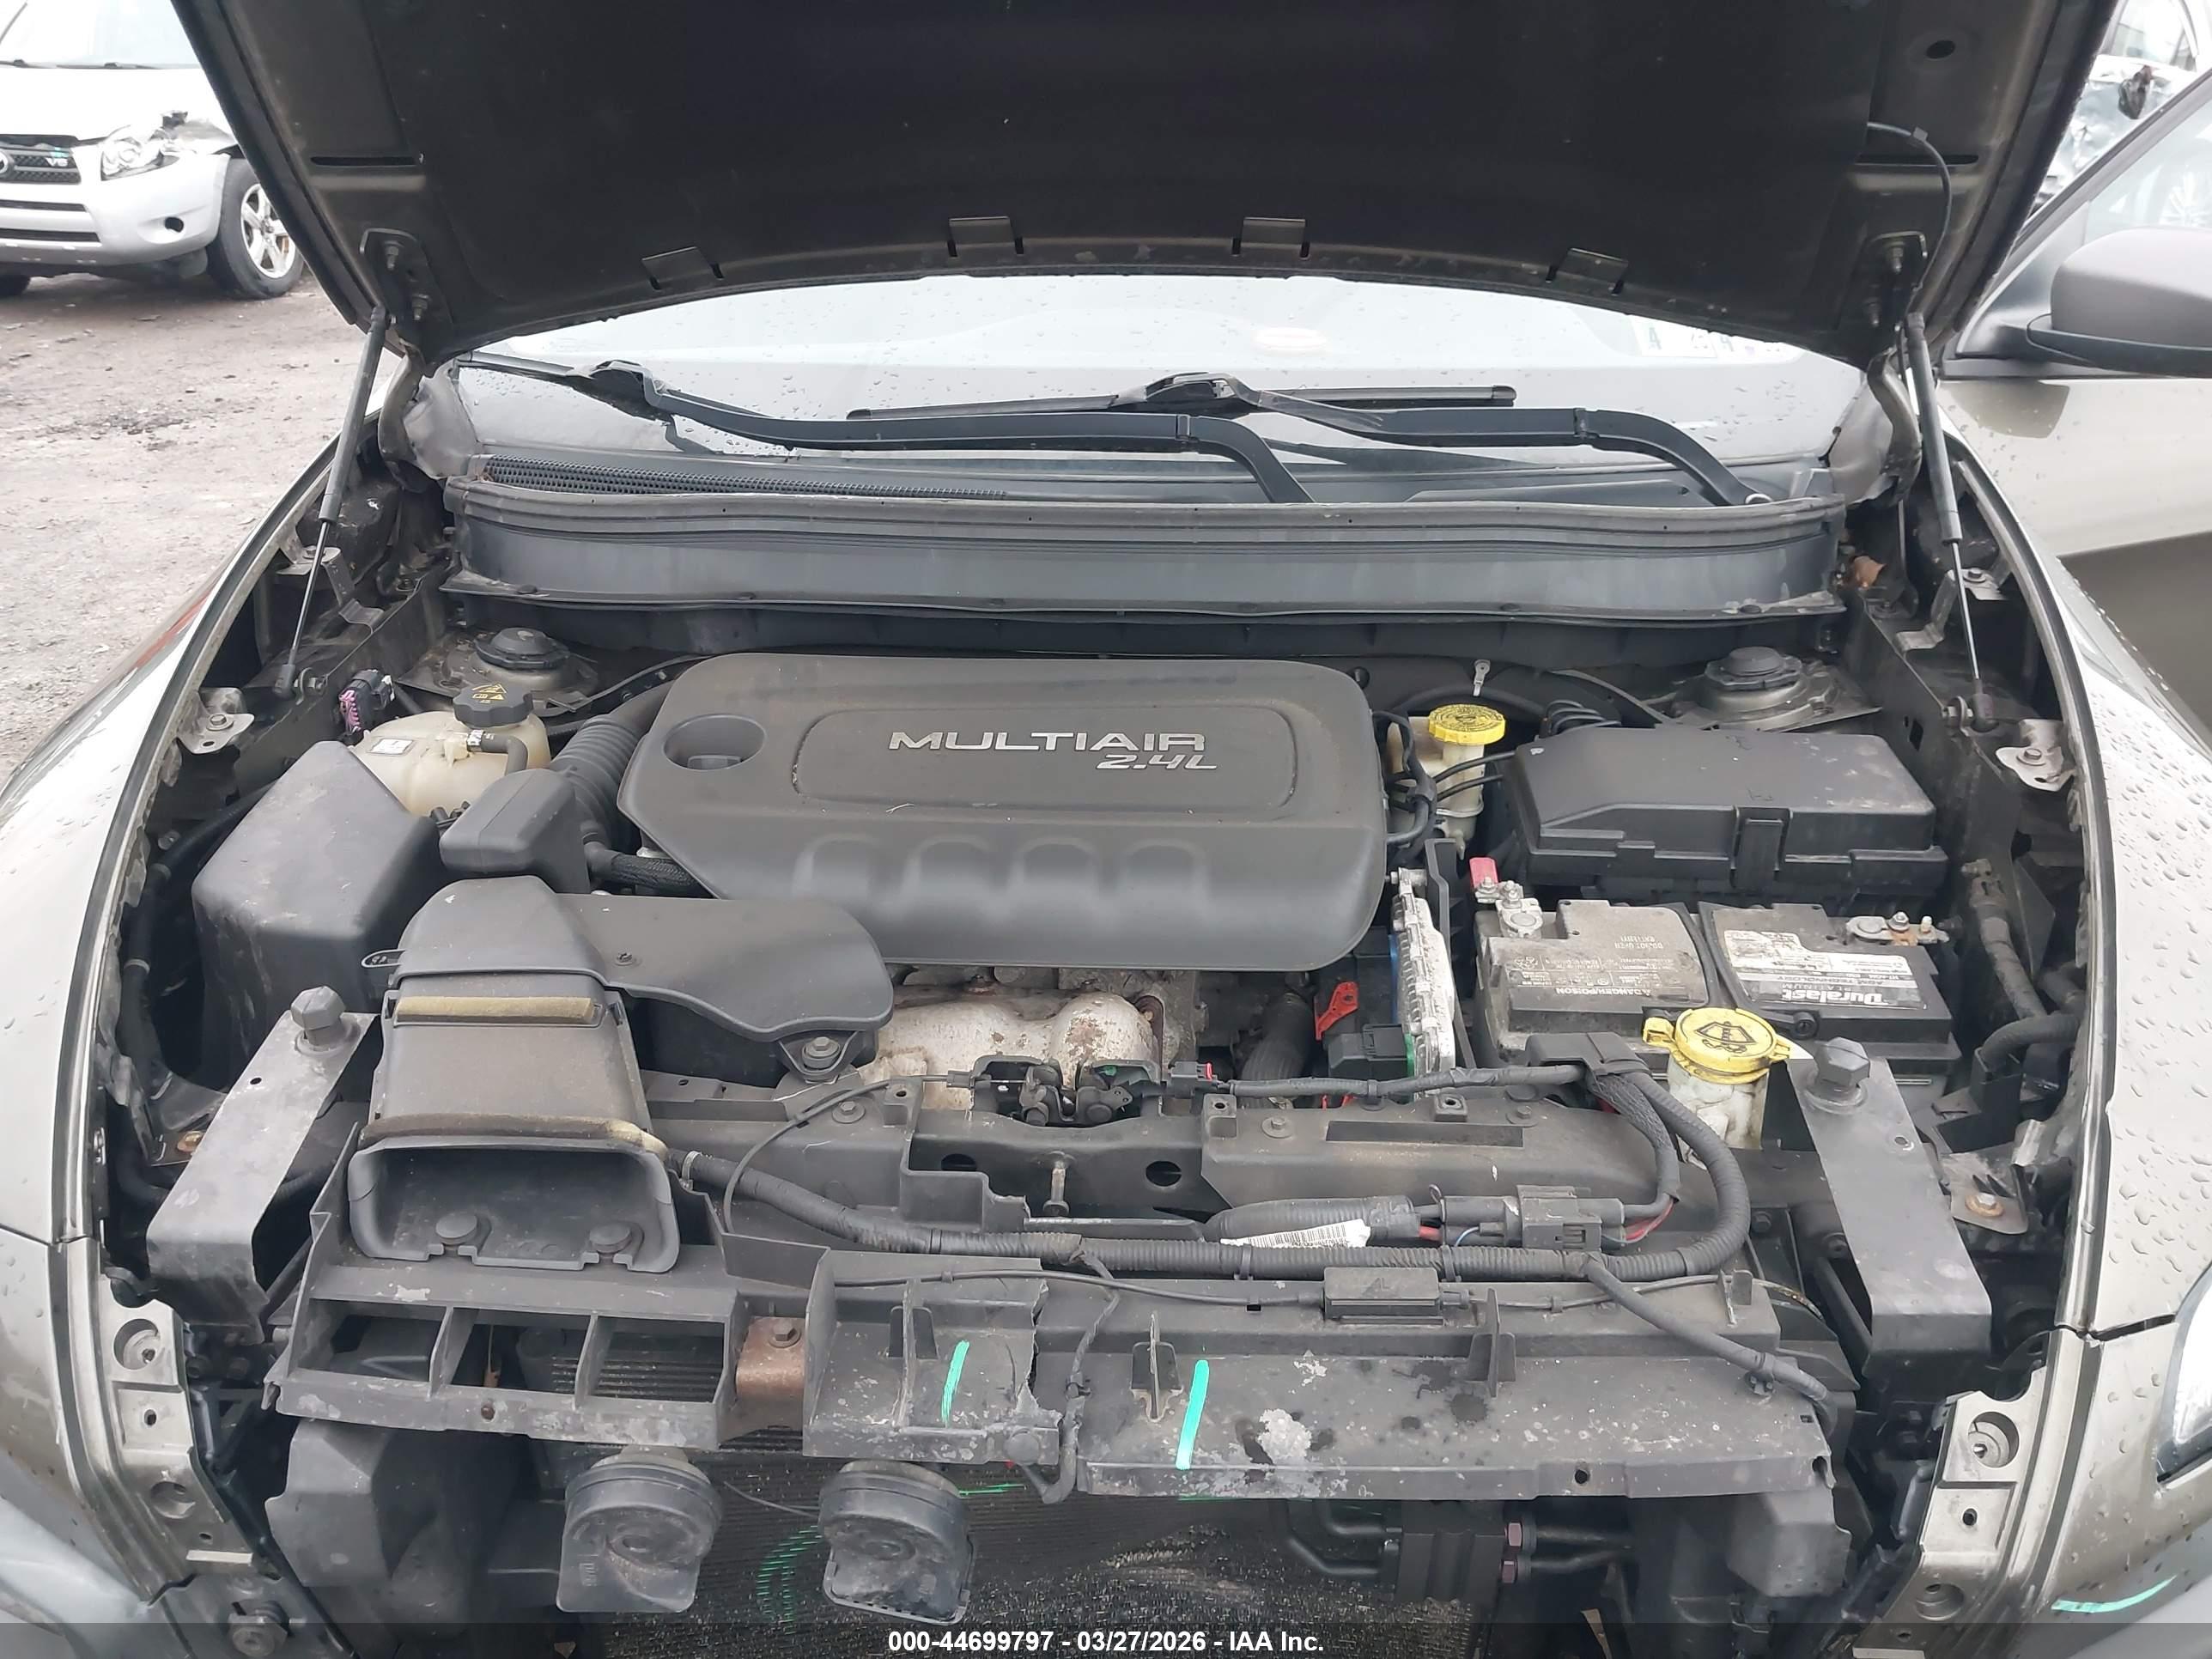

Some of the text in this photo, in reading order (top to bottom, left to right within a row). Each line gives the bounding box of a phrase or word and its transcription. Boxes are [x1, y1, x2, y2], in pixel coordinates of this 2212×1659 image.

[45, 157, 69, 167] V6
[888, 731, 1206, 752] MULTIAIR
[1095, 753, 1218, 770] 2.4L
[1777, 975, 1853, 984] TECHNOLOGY
[1782, 982, 1853, 992] PLATINUM
[1781, 988, 1888, 1006] Duralast
